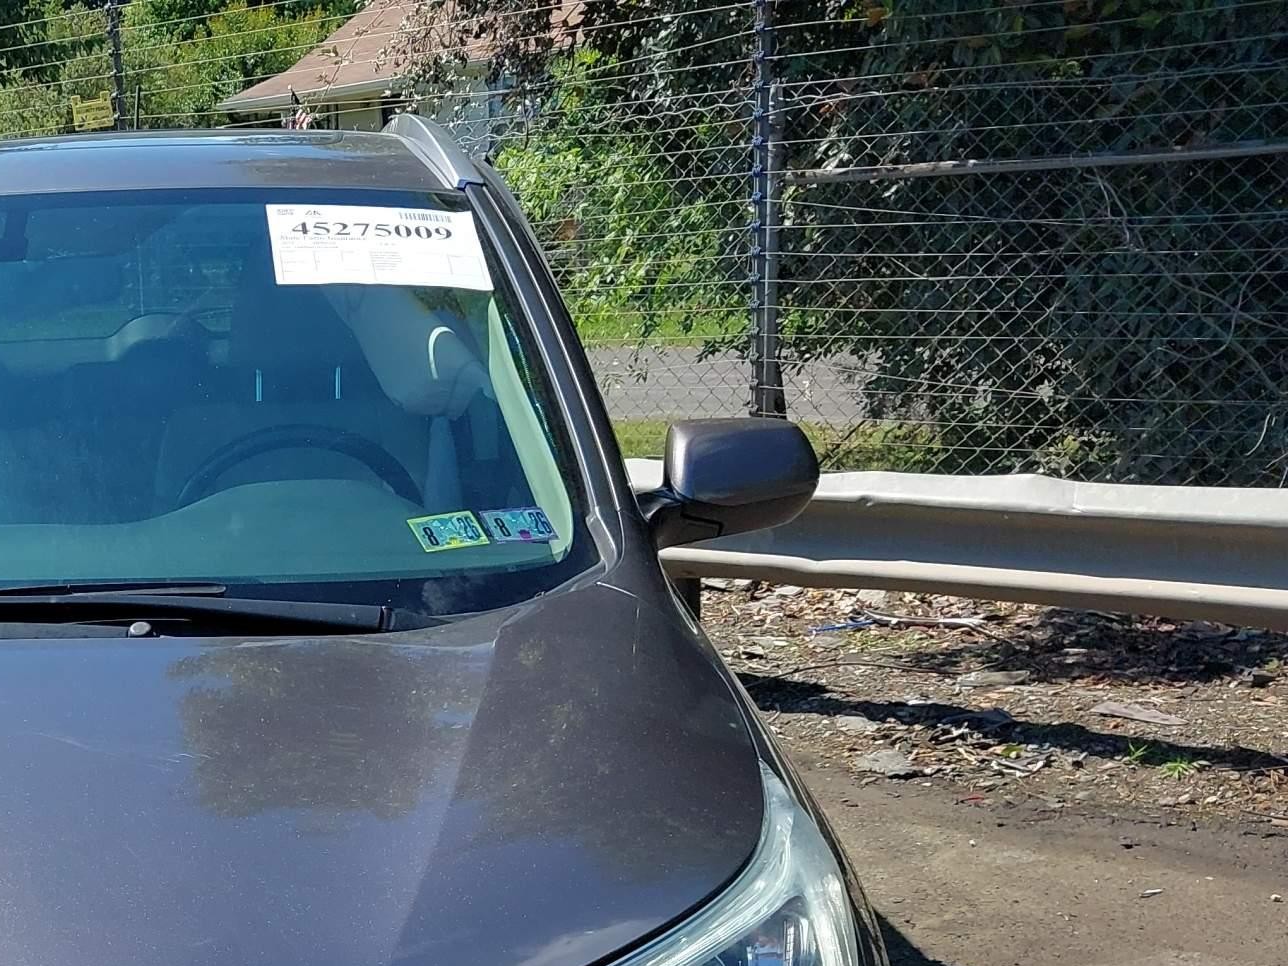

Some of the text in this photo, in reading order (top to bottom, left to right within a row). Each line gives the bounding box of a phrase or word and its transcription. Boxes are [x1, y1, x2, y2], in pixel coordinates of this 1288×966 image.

[291, 222, 452, 240] 45275009
[493, 511, 553, 537] 8 26
